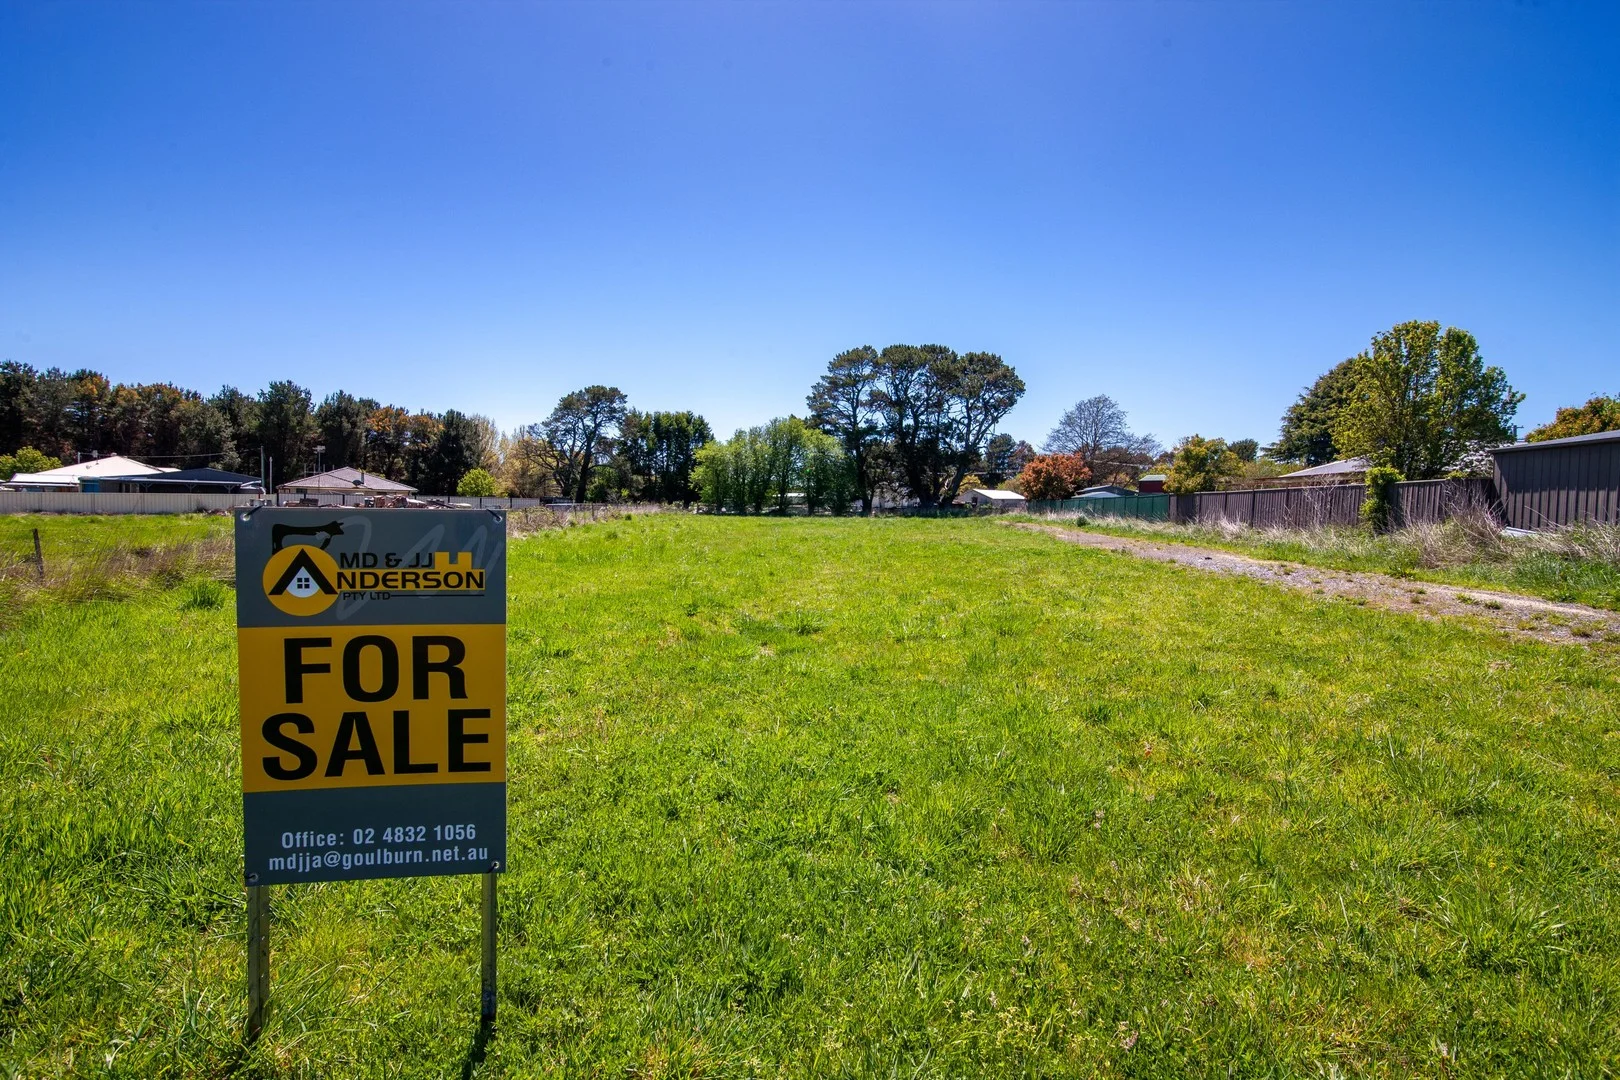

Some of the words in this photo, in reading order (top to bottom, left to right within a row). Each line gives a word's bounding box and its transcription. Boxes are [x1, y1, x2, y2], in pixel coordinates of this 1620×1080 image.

[340, 552, 378, 569] MD
[385, 552, 403, 569] &
[409, 552, 433, 569] JJ
[343, 591, 368, 601] PTY
[369, 591, 391, 601] LTD
[284, 635, 468, 704] FOR
[261, 708, 491, 781] SALE
[281, 831, 345, 849] Office:
[353, 828, 375, 845] 02
[383, 825, 426, 843] 4832
[433, 824, 476, 841] 1056
[268, 845, 488, 873] mdjja@goulburn.net.au
